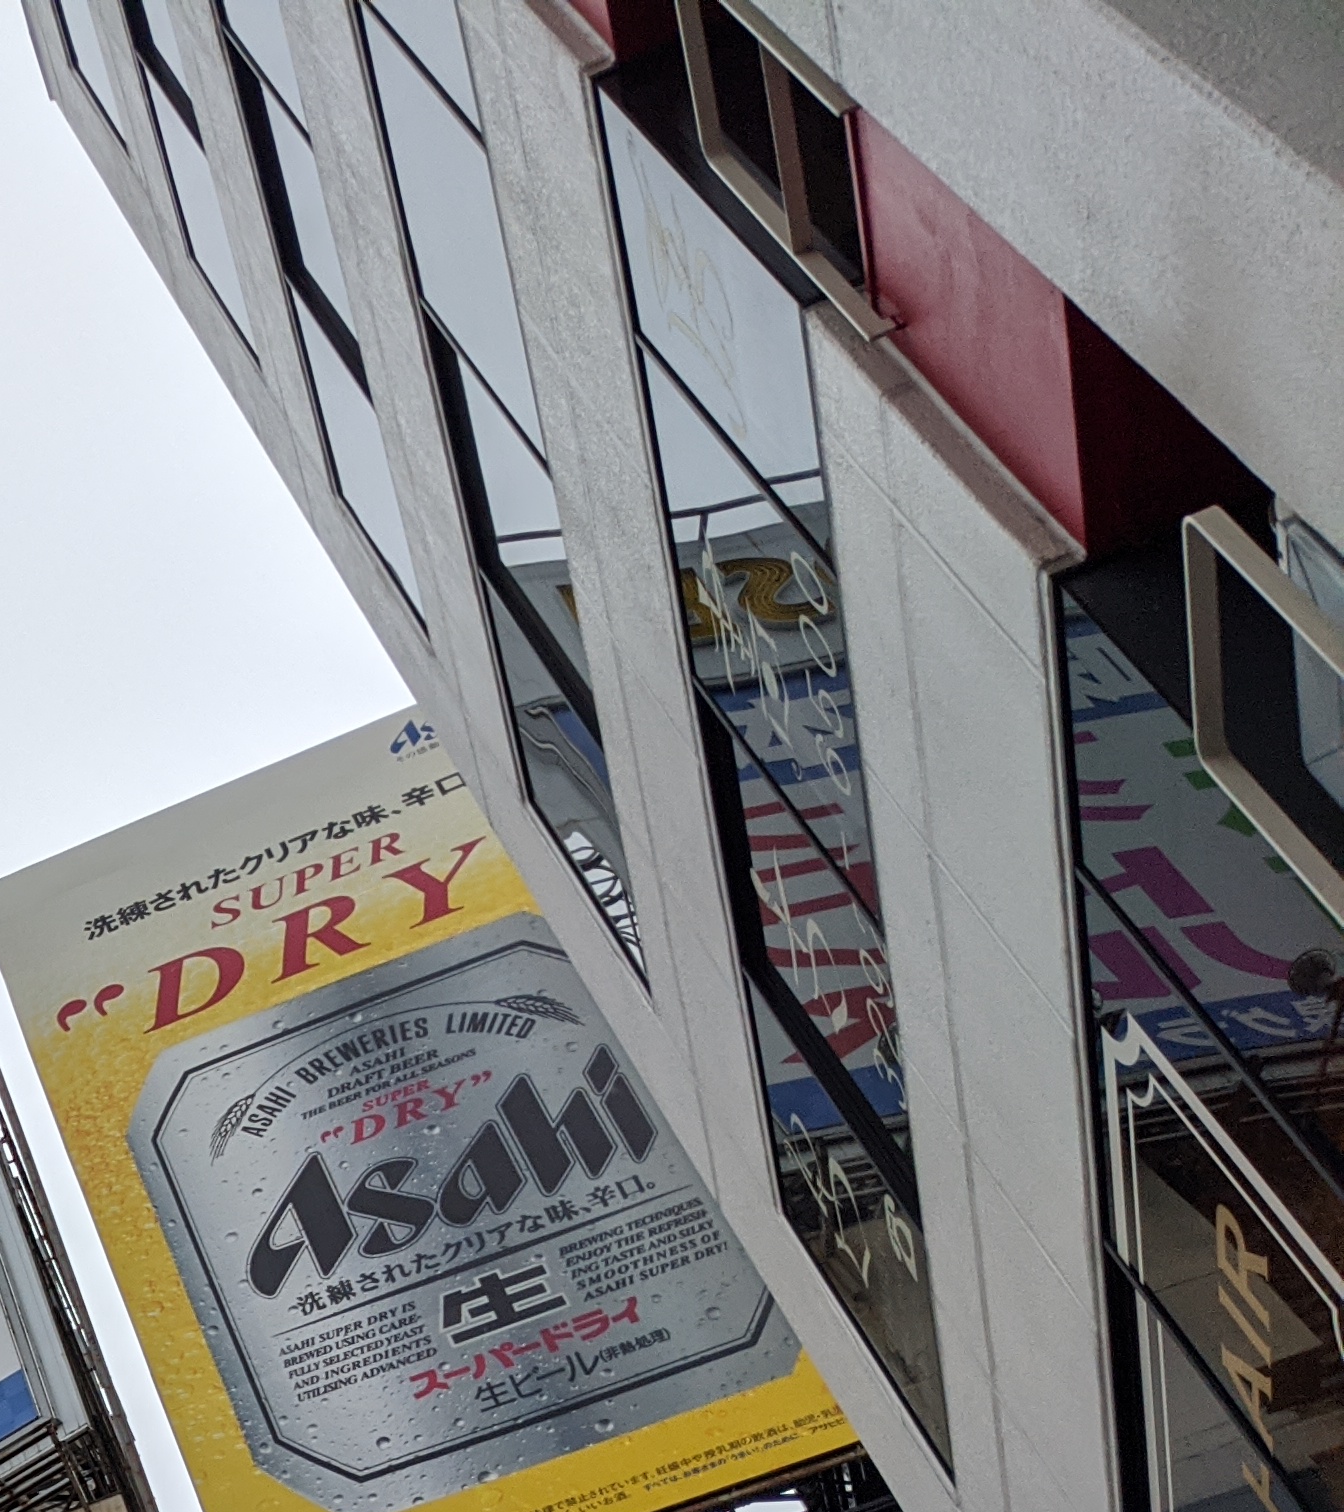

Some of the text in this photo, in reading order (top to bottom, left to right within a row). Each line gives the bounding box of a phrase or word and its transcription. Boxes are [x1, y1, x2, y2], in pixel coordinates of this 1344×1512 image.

[84, 772, 466, 940] 洗練されたクリアな味、辛口
[210, 832, 405, 929] SUPER
[241, 1012, 536, 1138] ASAHI BREWERIES LIMITED
[300, 1048, 477, 1121] THE BEER FOR ALL SEASONS
[327, 1049, 438, 1099] DRAFT BEER
[349, 1047, 406, 1077] ASAHI
[362, 1079, 431, 1113] SUPER
[246, 1043, 659, 1299] Asahi
[559, 1197, 703, 1257] BREWING TECHNIQUES
[565, 1242, 612, 1268] ENJOY
[614, 1231, 645, 1249] THE
[571, 1220, 714, 1280] ING TASTE AND SILKY
[576, 1230, 721, 1291] SMOOTHNESS OF
[584, 1241, 728, 1302] ASAHI SUPER DRY!
[278, 1300, 416, 1357] ASAHI SUPER DRY IS
[442, 1263, 571, 1347] 生
[283, 1344, 333, 1368] BREWED
[335, 1329, 376, 1350] USING
[288, 1324, 426, 1380] FULLY SELECTED YEAST
[293, 1334, 432, 1391] AND INGREDIENTS
[297, 1347, 438, 1402] UTILISING ADVANCED
[409, 1295, 640, 1400] スーパードライ
